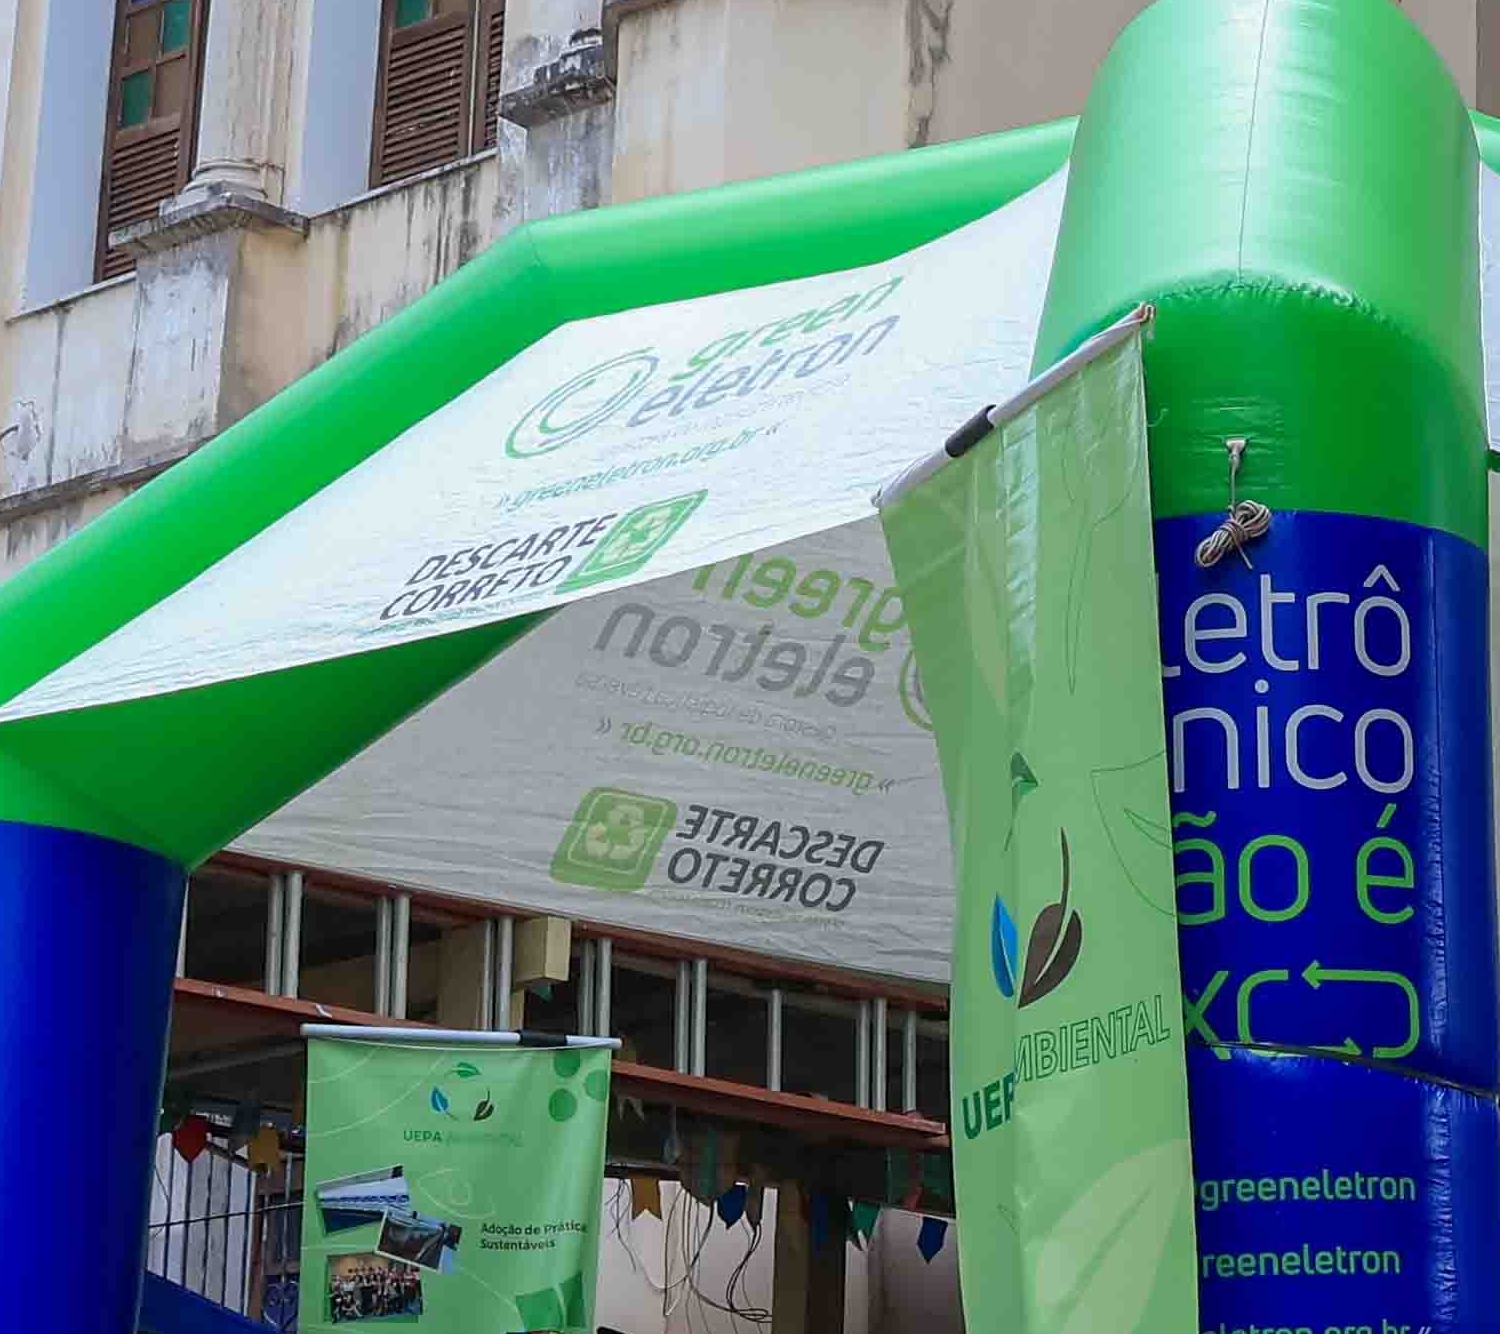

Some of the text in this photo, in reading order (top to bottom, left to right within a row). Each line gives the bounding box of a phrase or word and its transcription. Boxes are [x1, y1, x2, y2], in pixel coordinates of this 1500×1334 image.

[627, 315, 900, 428] eletron
[666, 277, 904, 381] green
[379, 555, 573, 621] CORRETO
[406, 514, 618, 587] DESCARTE
[1356, 803, 1416, 925] é
[1200, 1168, 1416, 1212] greeneletron
